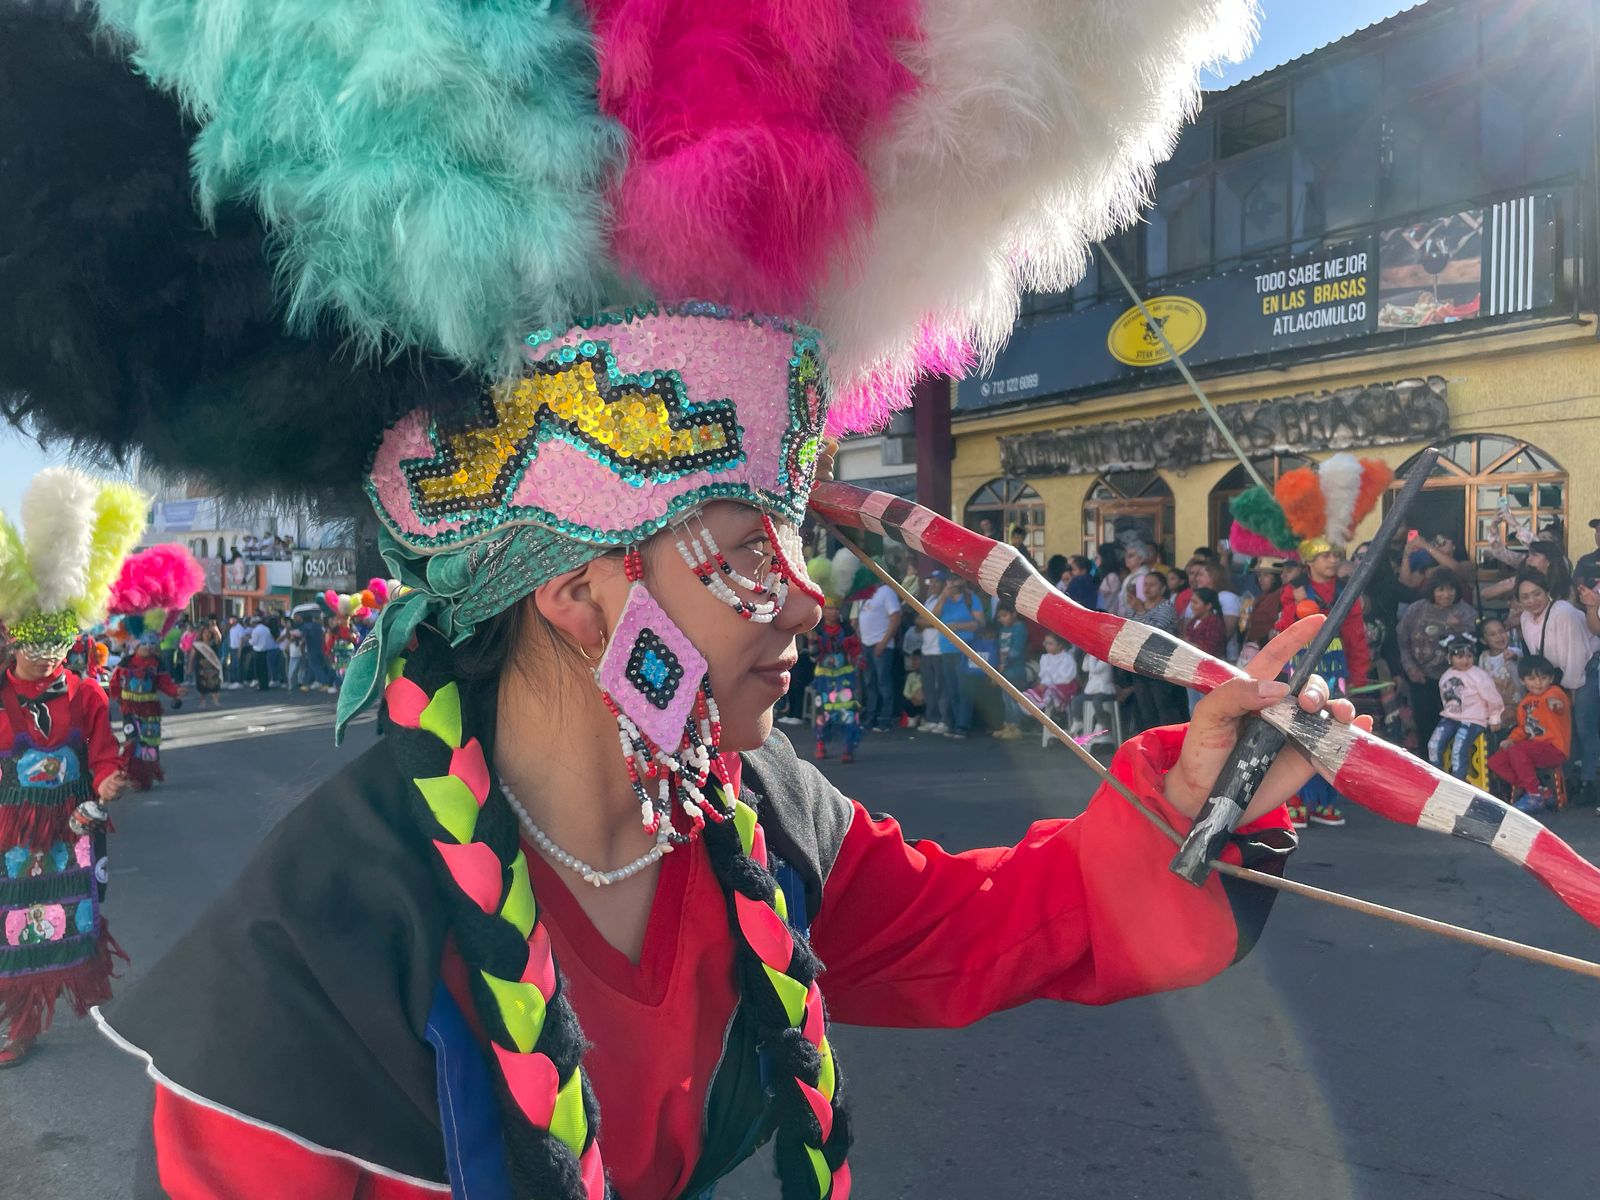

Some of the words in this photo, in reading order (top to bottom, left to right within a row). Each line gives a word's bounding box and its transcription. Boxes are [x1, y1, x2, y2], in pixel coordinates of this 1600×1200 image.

[1254, 270, 1286, 294] TODO
[1288, 262, 1322, 287] SABE
[1324, 253, 1367, 280] MEJOR
[1262, 295, 1279, 316] EN
[1281, 289, 1306, 311] LAS
[1313, 277, 1366, 305] BRASAS
[1272, 301, 1366, 337] ATLACOMULCO
[992, 379, 1005, 395] 712
[305, 558, 326, 577] OSO
